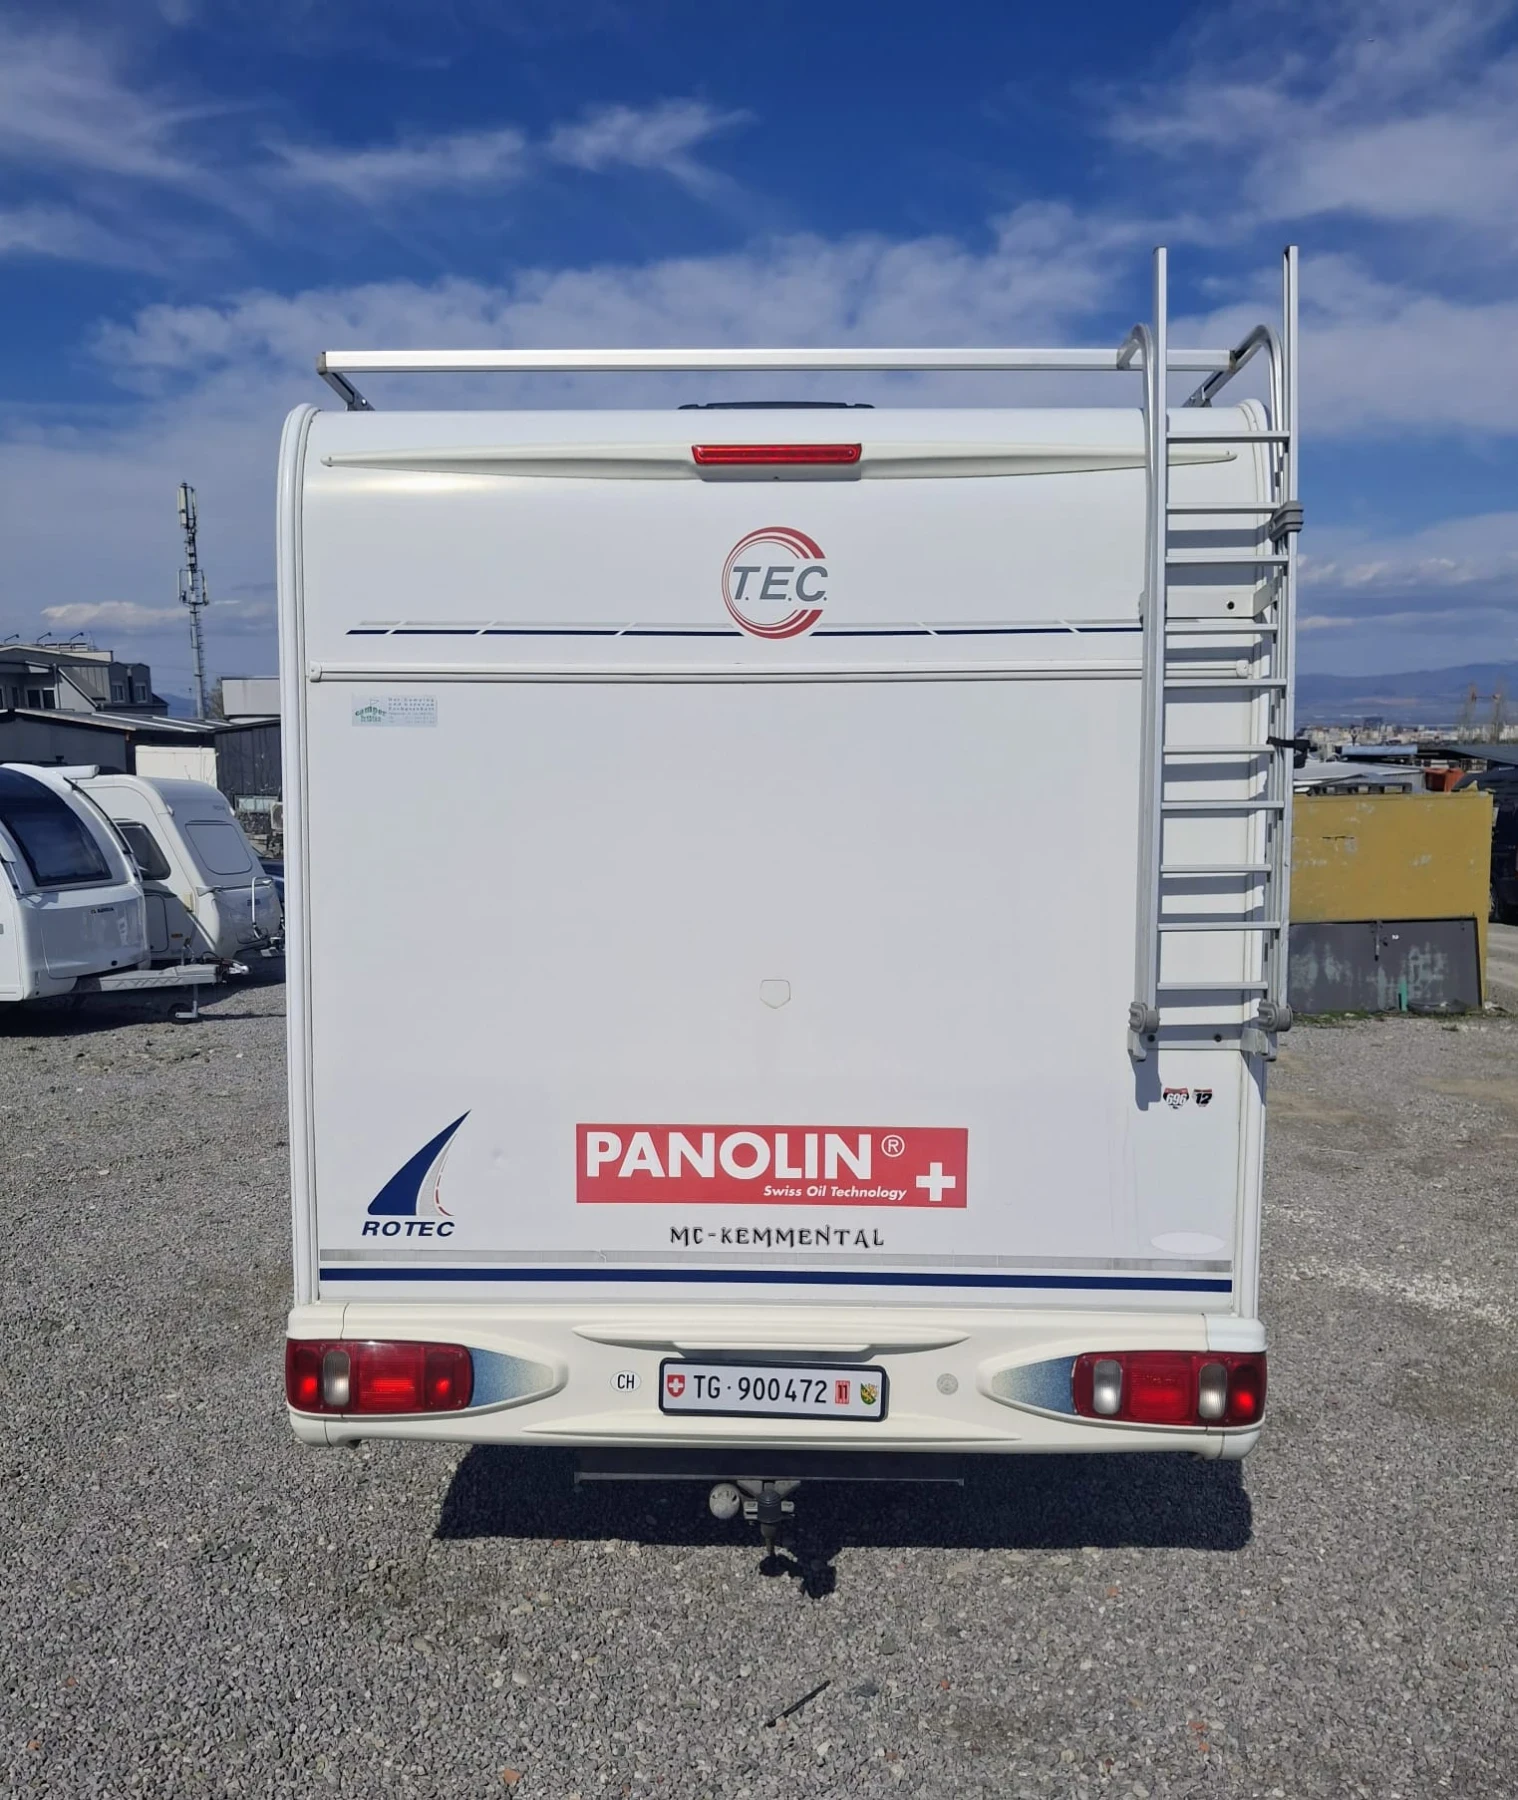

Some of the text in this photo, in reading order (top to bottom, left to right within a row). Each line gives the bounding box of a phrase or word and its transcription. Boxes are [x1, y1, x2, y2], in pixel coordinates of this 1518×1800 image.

[1166, 1093, 1187, 1105] 696
[1196, 1093, 1212, 1104] 12
[586, 1131, 872, 1180] PANOLIN
[763, 1184, 907, 1201] Swiss Oil Technology
[361, 1220, 456, 1237] ROTEC
[669, 1224, 885, 1249] MC-KEMMENTAL
[616, 1374, 636, 1390] CH
